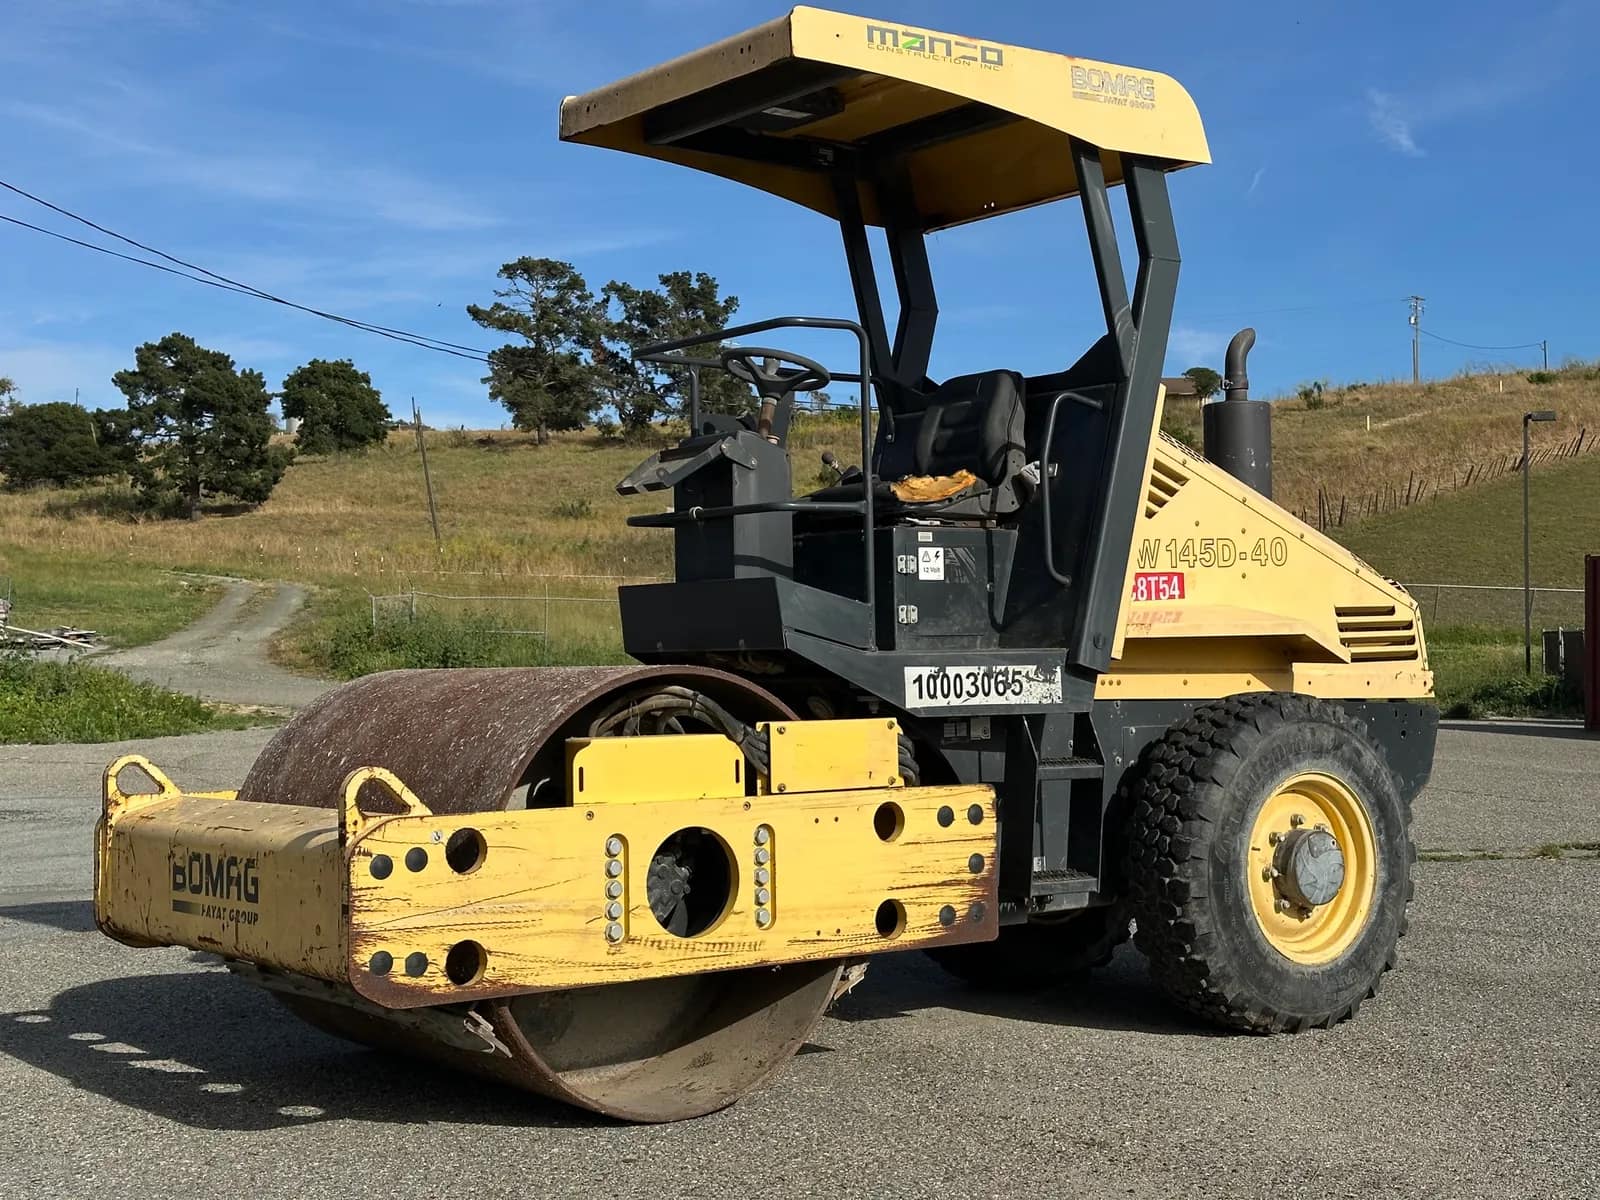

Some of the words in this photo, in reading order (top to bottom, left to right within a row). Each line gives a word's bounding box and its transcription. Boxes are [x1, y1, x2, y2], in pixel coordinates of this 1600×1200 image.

[867, 43, 971, 67] CONSTRUCTION
[980, 62, 1001, 72] INC
[1071, 65, 1155, 102] BOMAG
[1131, 575, 1180, 601] 8T54
[912, 670, 1023, 700] 10003065
[172, 851, 259, 904] BOMAG
[228, 908, 259, 926] GROUP
